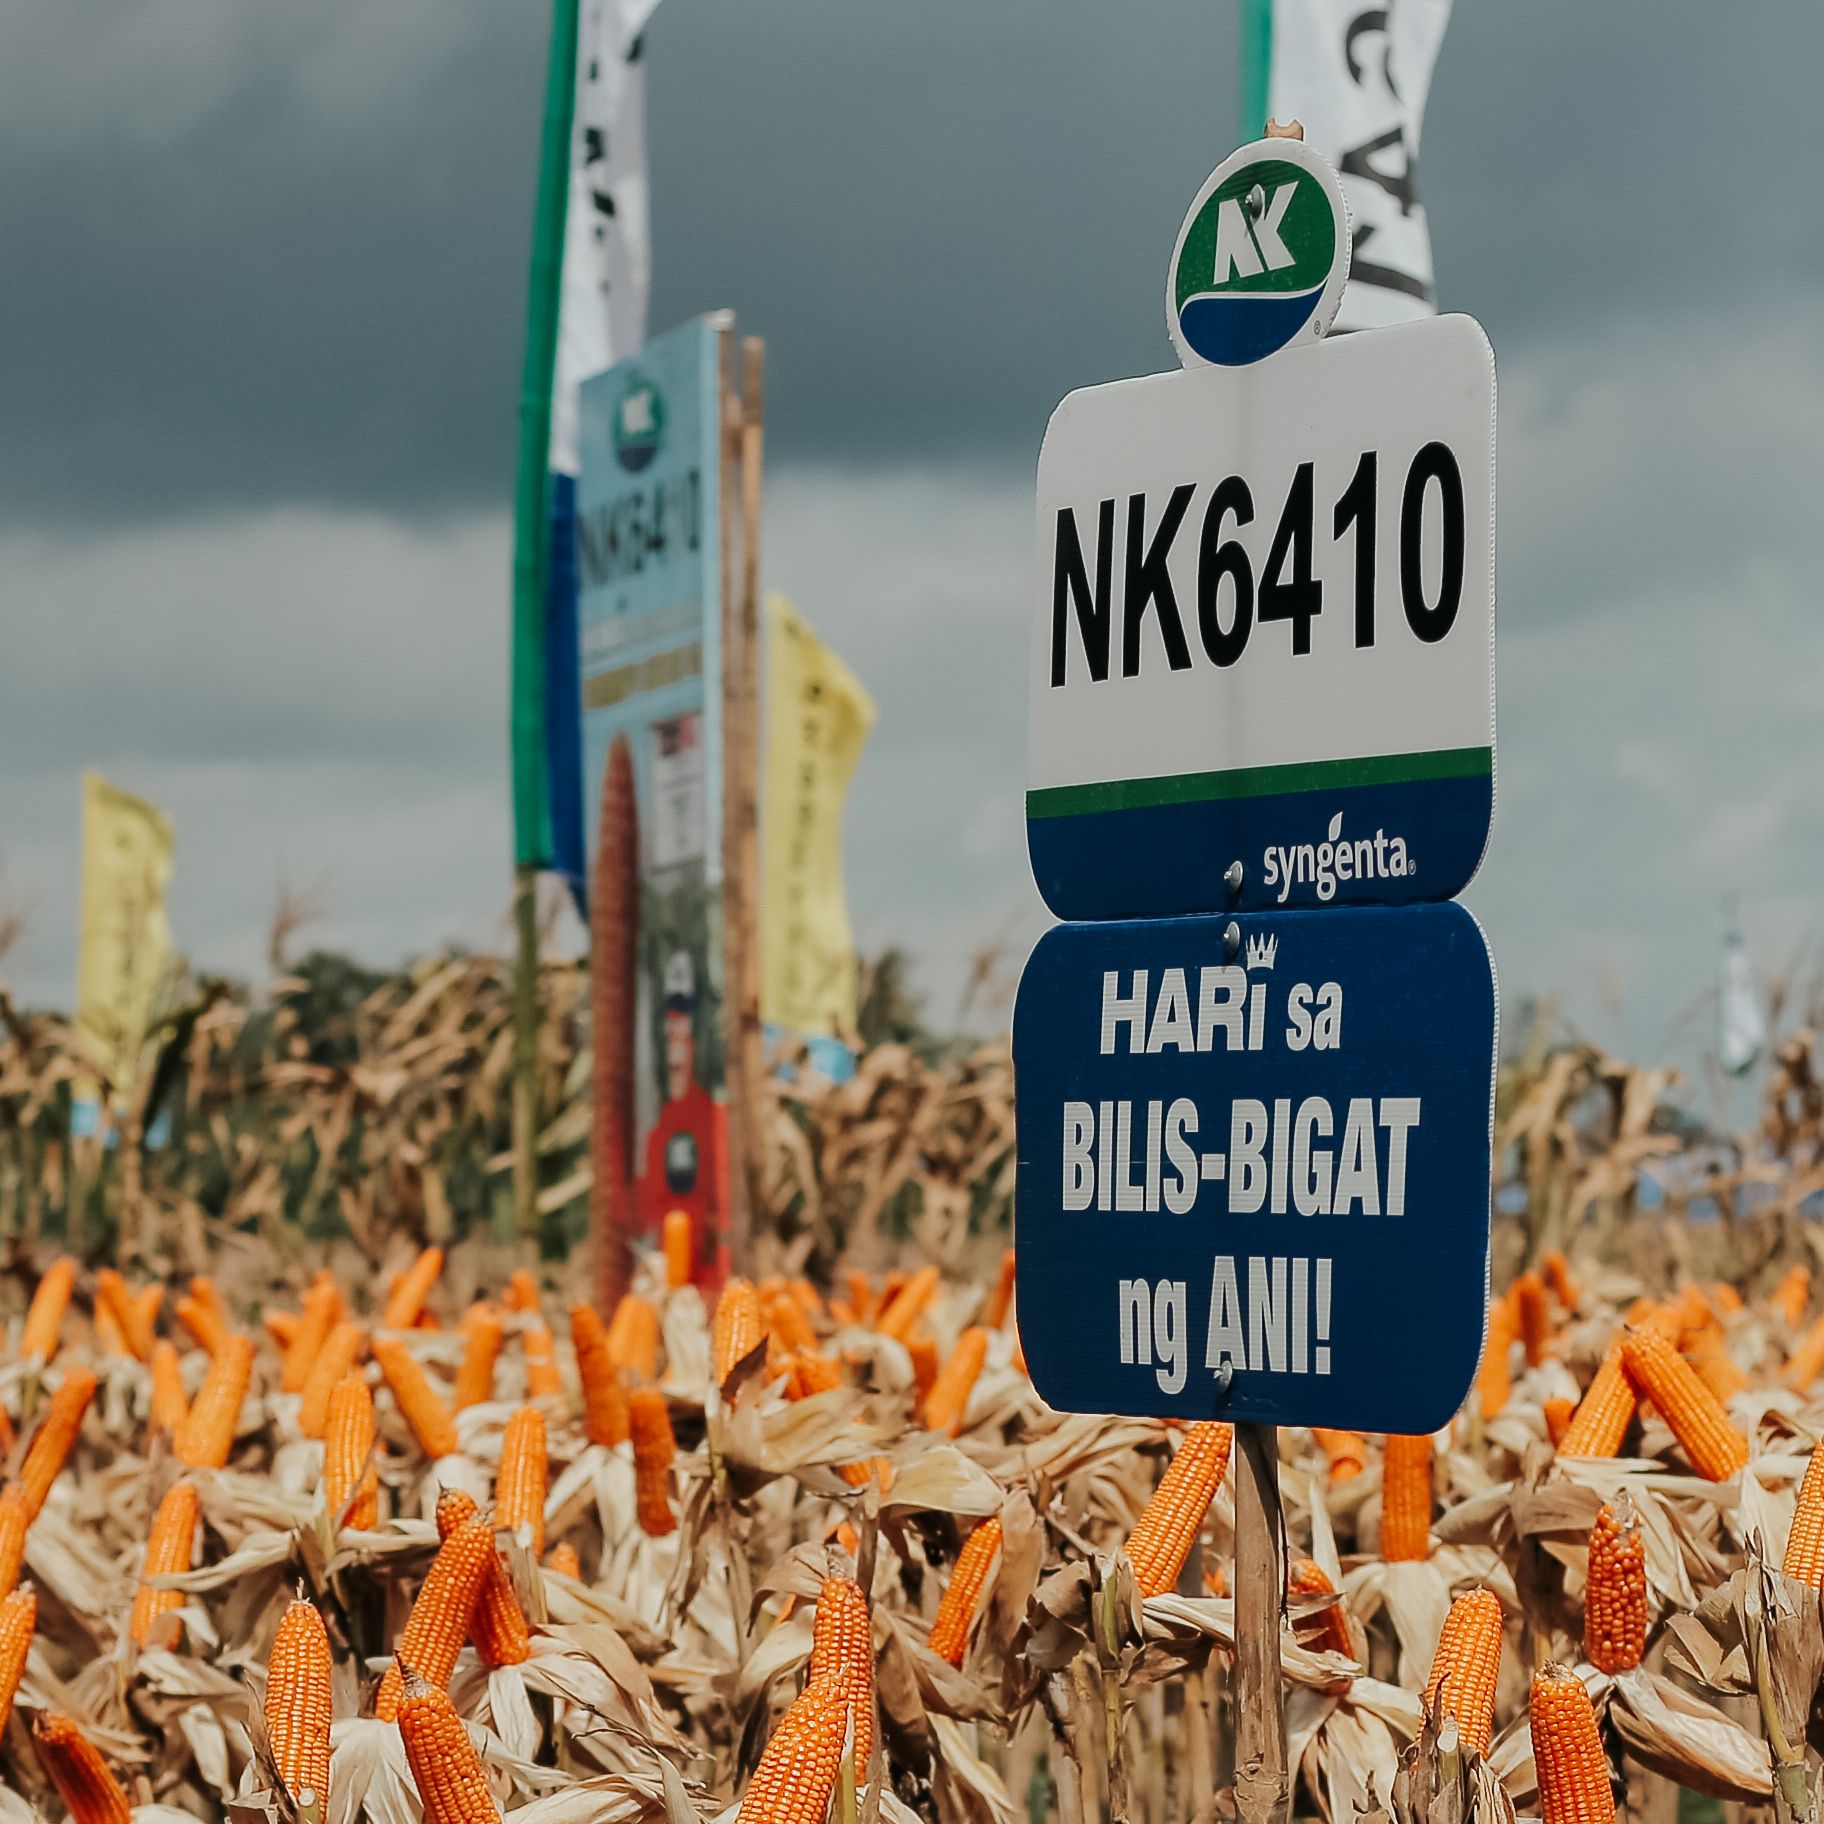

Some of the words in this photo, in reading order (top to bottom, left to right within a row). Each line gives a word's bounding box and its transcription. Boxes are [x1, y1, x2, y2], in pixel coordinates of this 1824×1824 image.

[1213, 181, 1299, 285] NK
[1050, 441, 1466, 688] NK6410
[1263, 822, 1409, 903] syngenta
[1285, 981, 1343, 1051] sa
[1062, 1096, 1421, 1217] BILIS-BIGAT
[1119, 1278, 1187, 1394] ng
[1205, 1256, 1333, 1374] ANI!
